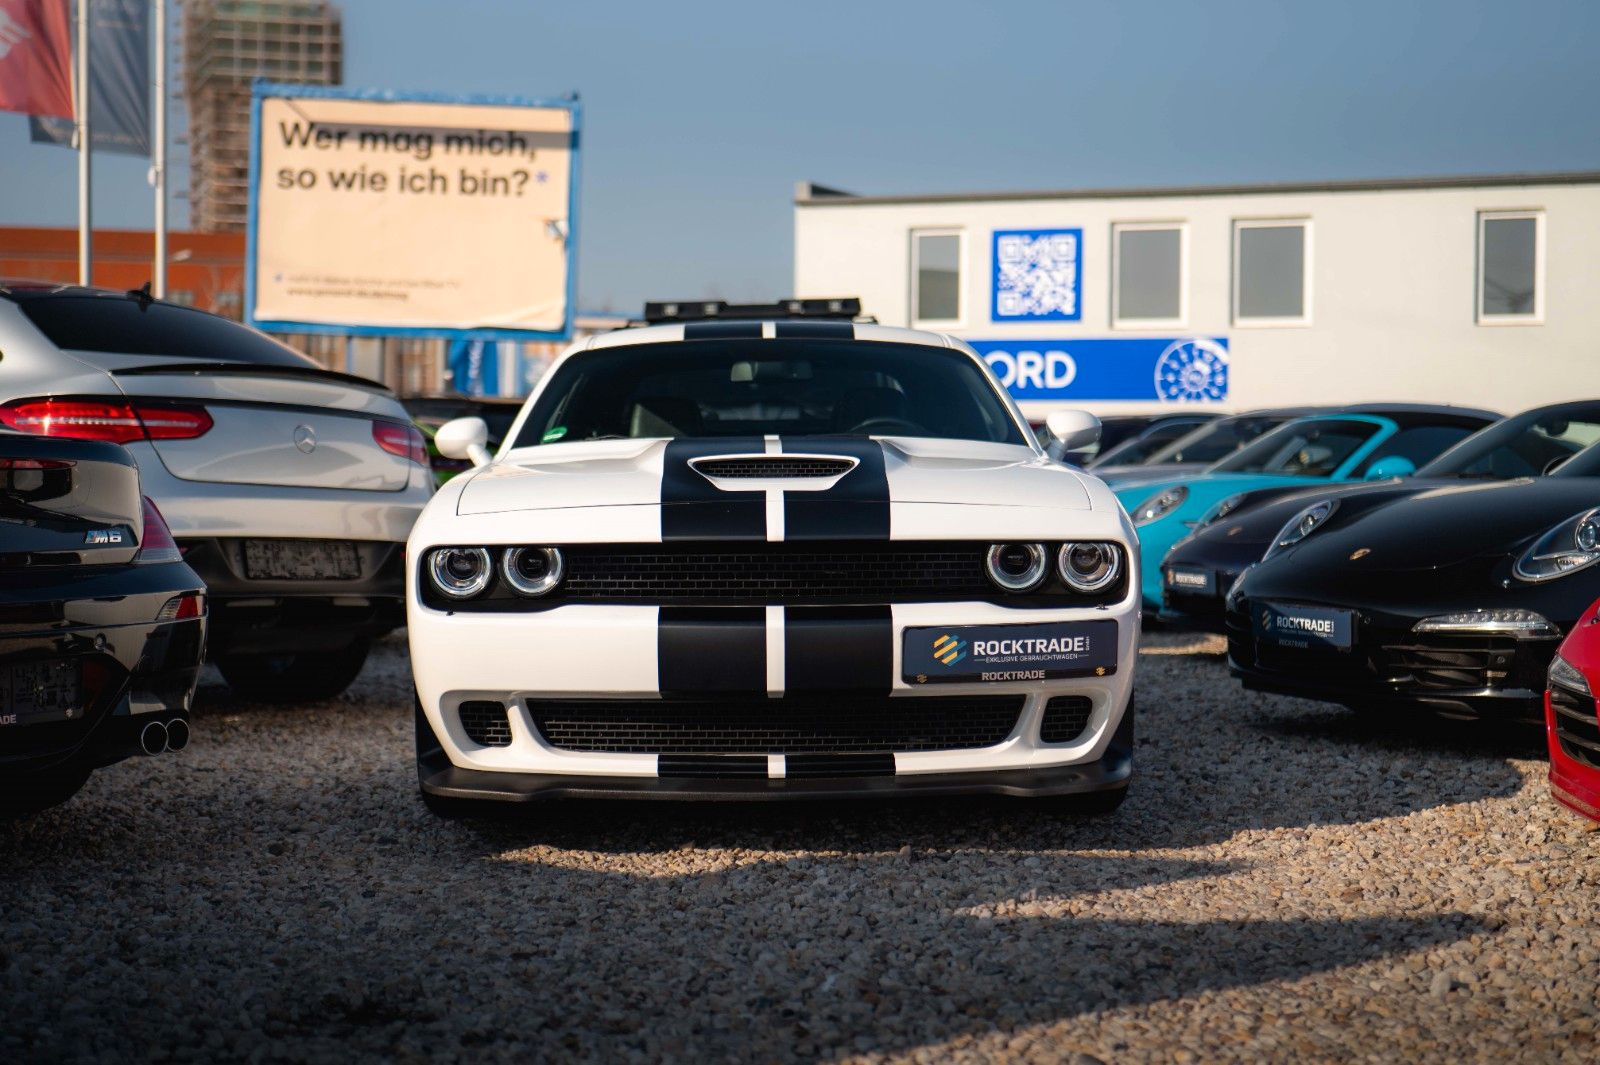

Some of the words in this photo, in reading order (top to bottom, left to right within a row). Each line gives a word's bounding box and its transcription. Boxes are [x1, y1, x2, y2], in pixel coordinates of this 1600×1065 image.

[279, 121, 348, 148] Wer
[360, 128, 433, 161] mag
[444, 129, 537, 161] mich,
[276, 168, 317, 190] so
[327, 164, 388, 192] wie
[400, 166, 447, 193] ich
[1276, 616, 1331, 633] ROCKTRADE
[973, 636, 1085, 656] ROCKTRADE
[985, 655, 1019, 664] EXKLUSIVE
[1019, 653, 1078, 663] GEBRAUCHTWAGEN
[981, 669, 1046, 681] ROCKTRADE
